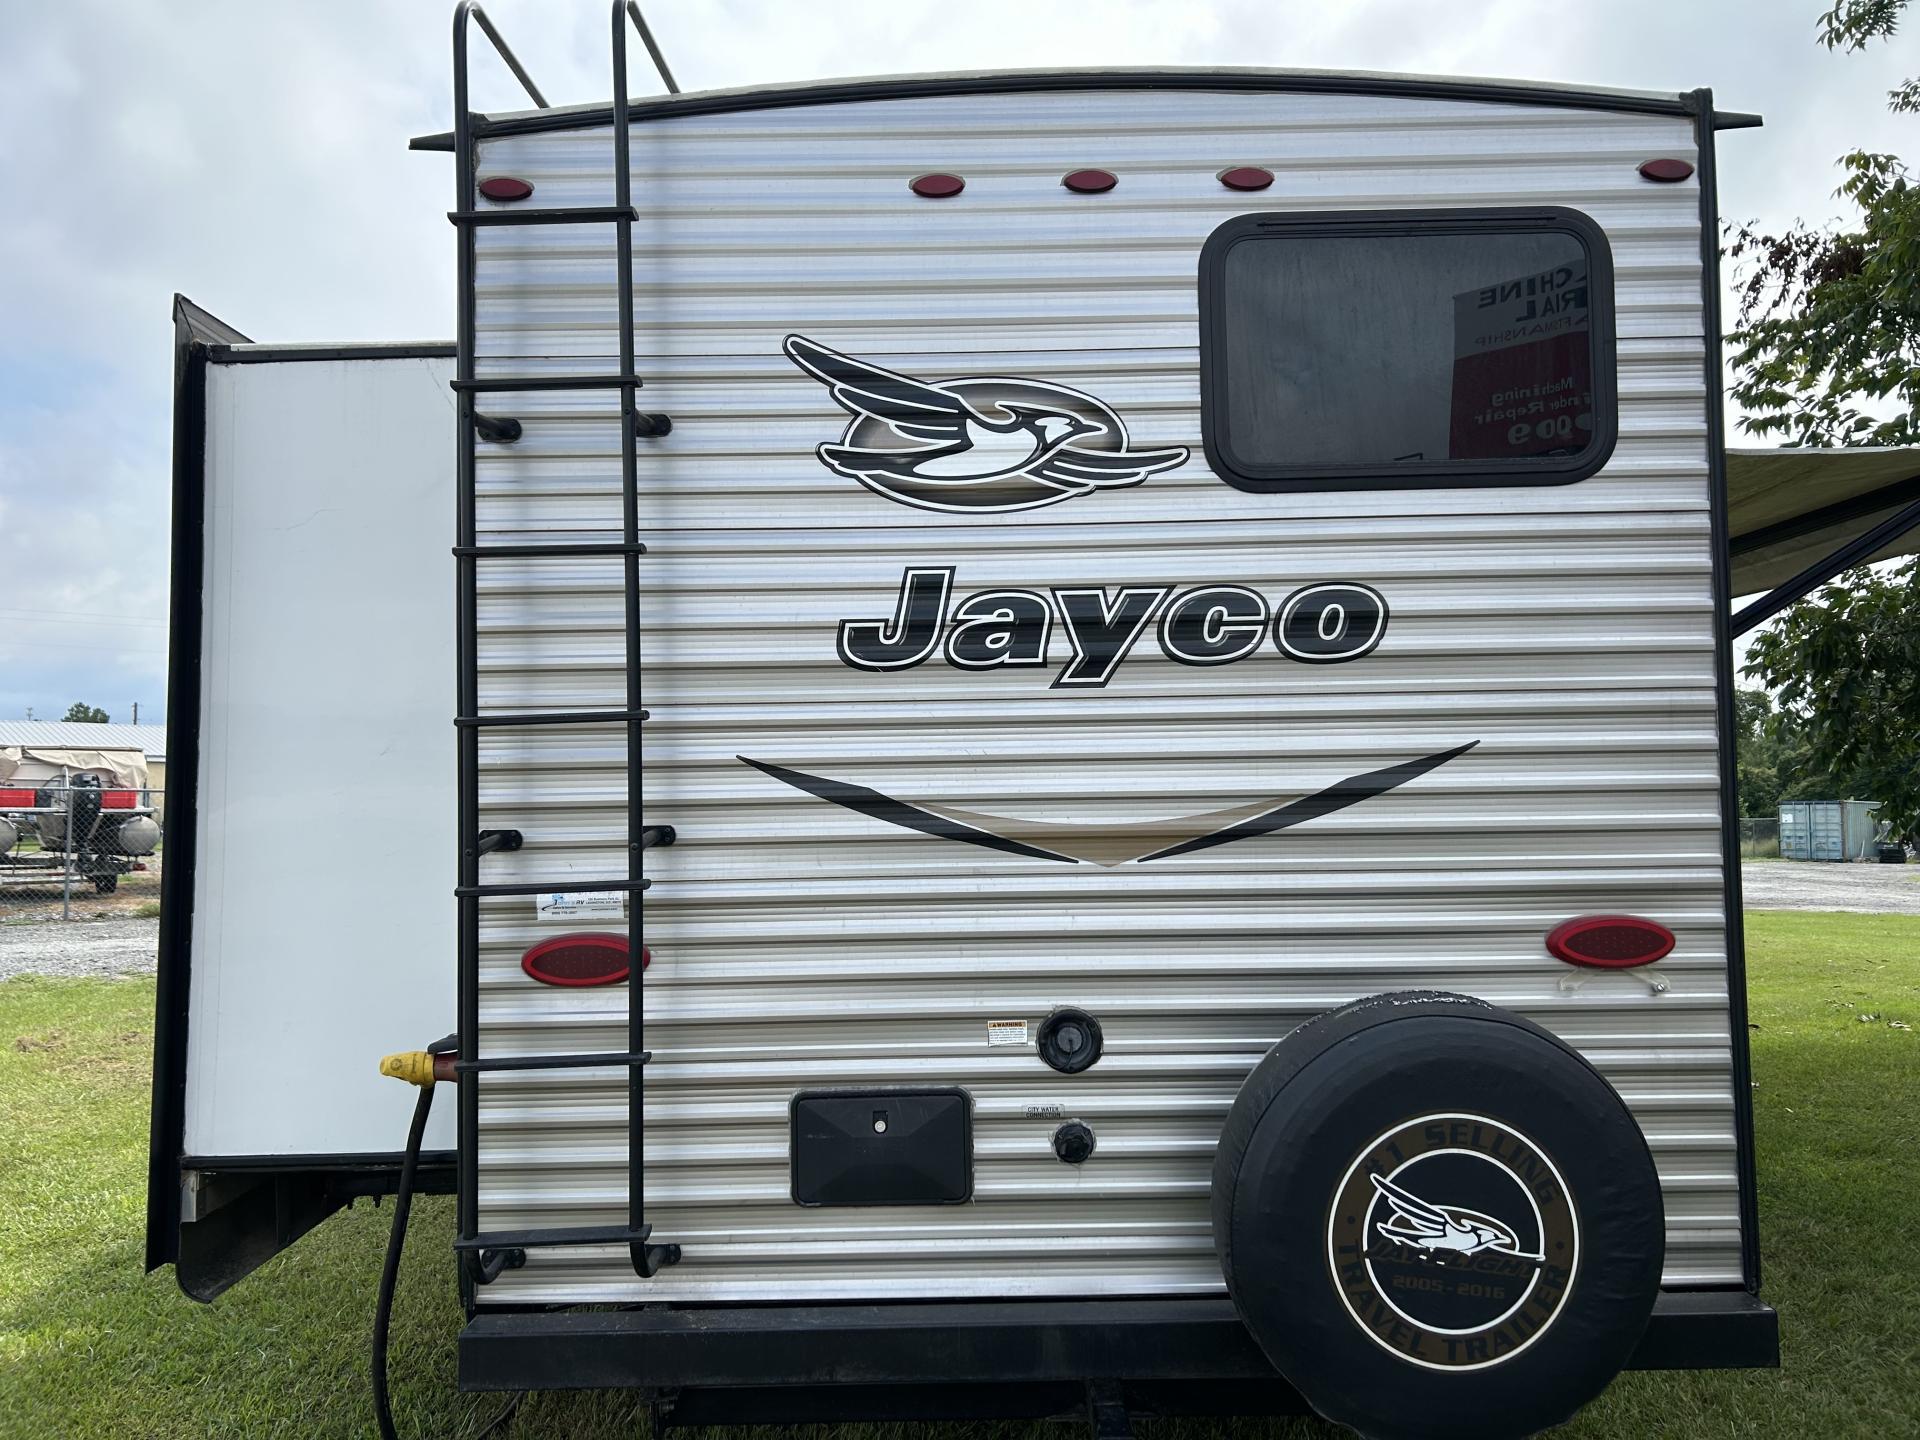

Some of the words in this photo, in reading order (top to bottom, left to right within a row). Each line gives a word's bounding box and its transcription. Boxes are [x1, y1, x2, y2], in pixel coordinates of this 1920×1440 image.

[836, 565, 1391, 690] Jayco
[1025, 1112, 1061, 1120] CONNECTION
[1426, 1123, 1561, 1208] SELLING
[1338, 1239, 1427, 1359] TRAVEL
[1442, 1264, 1568, 1362] TRAILER
[1392, 1274, 1444, 1292] 2005
[1456, 1283, 1505, 1300] 2016
